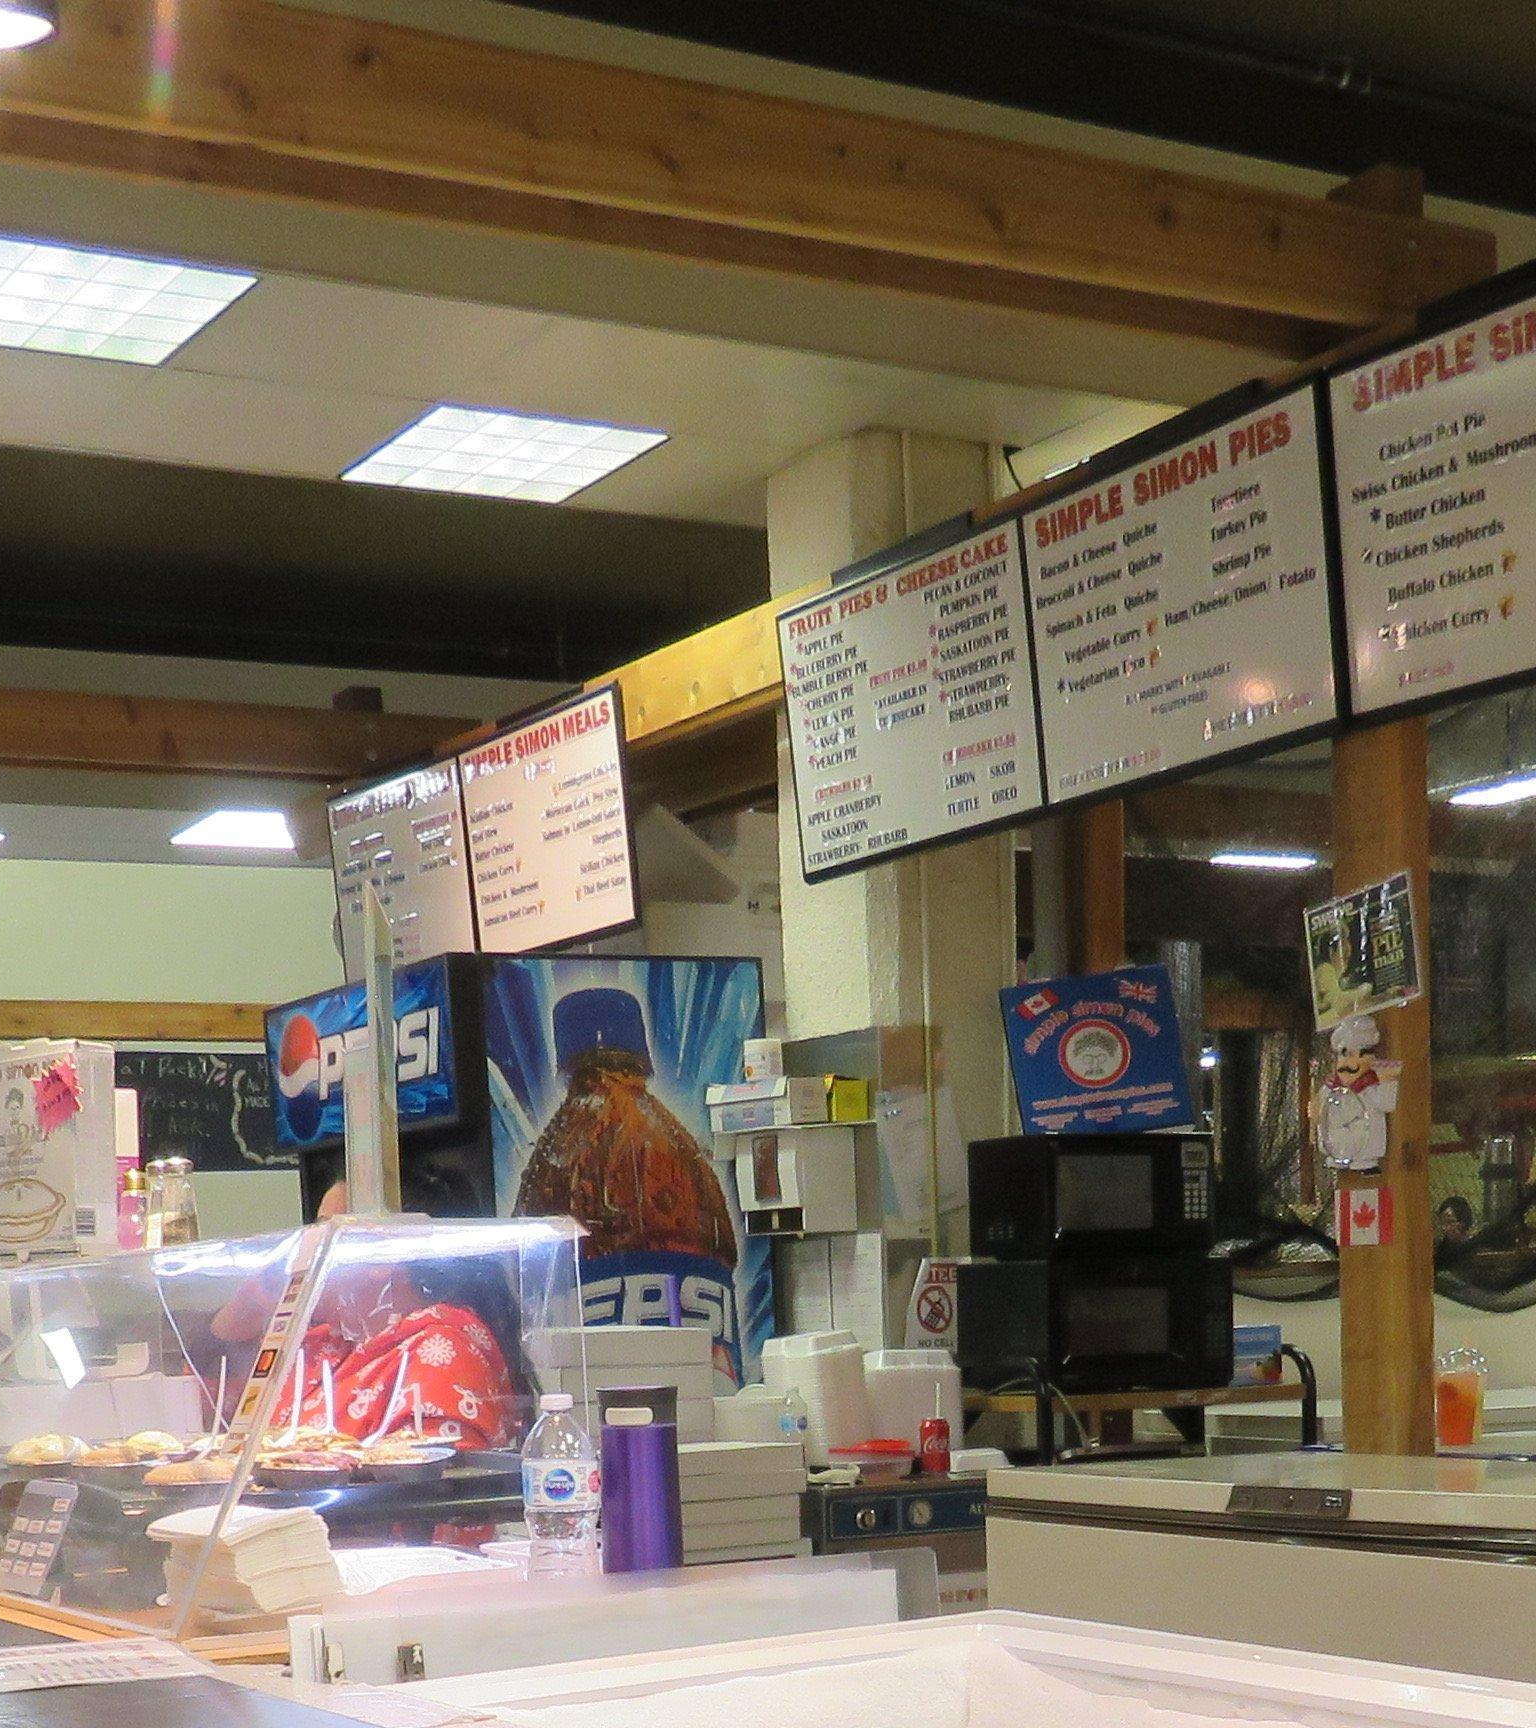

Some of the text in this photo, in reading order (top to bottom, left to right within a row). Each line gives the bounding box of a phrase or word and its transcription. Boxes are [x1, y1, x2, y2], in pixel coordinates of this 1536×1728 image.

[1351, 331, 1476, 414] SIMPLE
[1378, 431, 1433, 463] Chicken
[1463, 411, 1487, 434] Pie
[1034, 411, 1293, 549] SIMPLE SIMON PIES
[1351, 482, 1388, 504] Swiss
[1391, 463, 1445, 492] Chicken
[1384, 488, 1486, 530] Butter Chicken
[1376, 519, 1506, 568] Chicken Shepherds
[1211, 551, 1252, 578] Shrimp
[788, 605, 833, 640] FRUIT
[838, 588, 873, 620] PIES
[895, 555, 959, 597] CHEESE
[960, 532, 1009, 569] CAKE
[982, 584, 998, 602] PIE
[1387, 561, 1495, 604] Buffalo Chicken
[992, 603, 1008, 621] PIE
[1395, 607, 1491, 646] hicken Curry
[803, 630, 845, 656] APPLE PIE
[995, 626, 1010, 644] PIE
[844, 644, 858, 662] PIE
[854, 659, 869, 676] PIE
[1001, 648, 1016, 665] PIE
[805, 682, 855, 713] CHERRY PIE
[841, 704, 855, 722] PIE
[994, 692, 1010, 711] PIE
[515, 721, 561, 758] SIMON
[563, 700, 611, 741] MEALS
[815, 745, 858, 771] PEACH PIE
[807, 793, 883, 827] APPLE CRANBERRY
[947, 786, 1018, 817] TURTLE OREO
[821, 817, 869, 842] SASKATOON
[867, 828, 908, 850] RHUBARB
[319, 1006, 440, 1101] PSI
